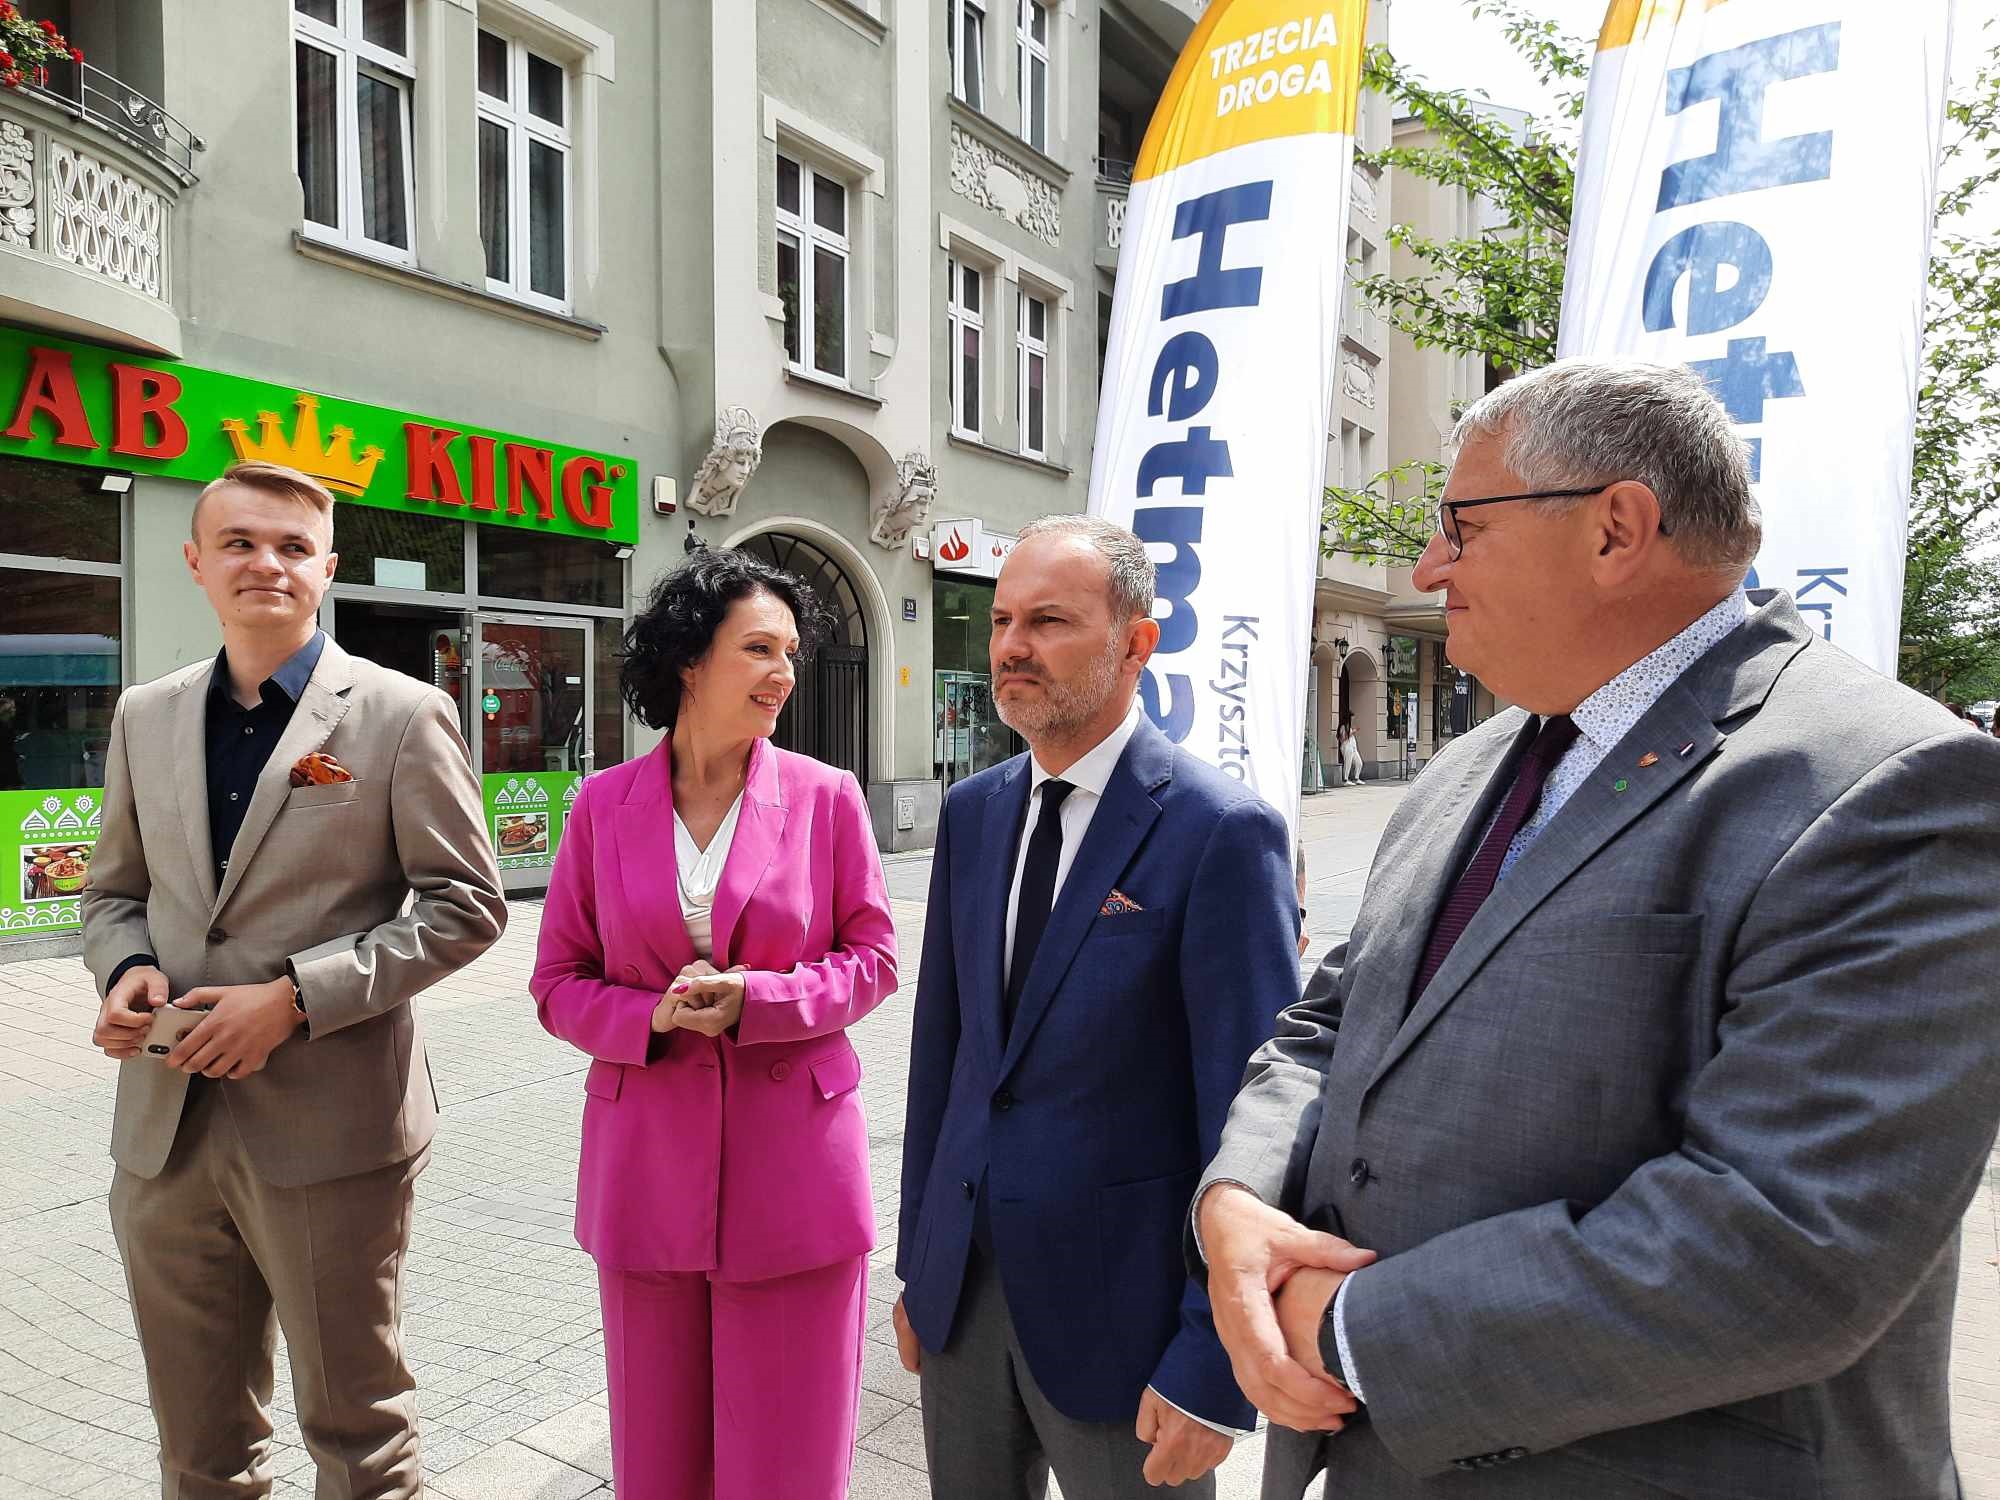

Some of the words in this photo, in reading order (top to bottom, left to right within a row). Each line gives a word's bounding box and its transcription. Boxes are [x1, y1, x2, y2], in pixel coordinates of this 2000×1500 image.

[1210, 12, 1337, 80] TRZECIA
[1216, 59, 1332, 117] DROGA
[403, 423, 614, 529] KING
[1796, 567, 1849, 641] Kr
